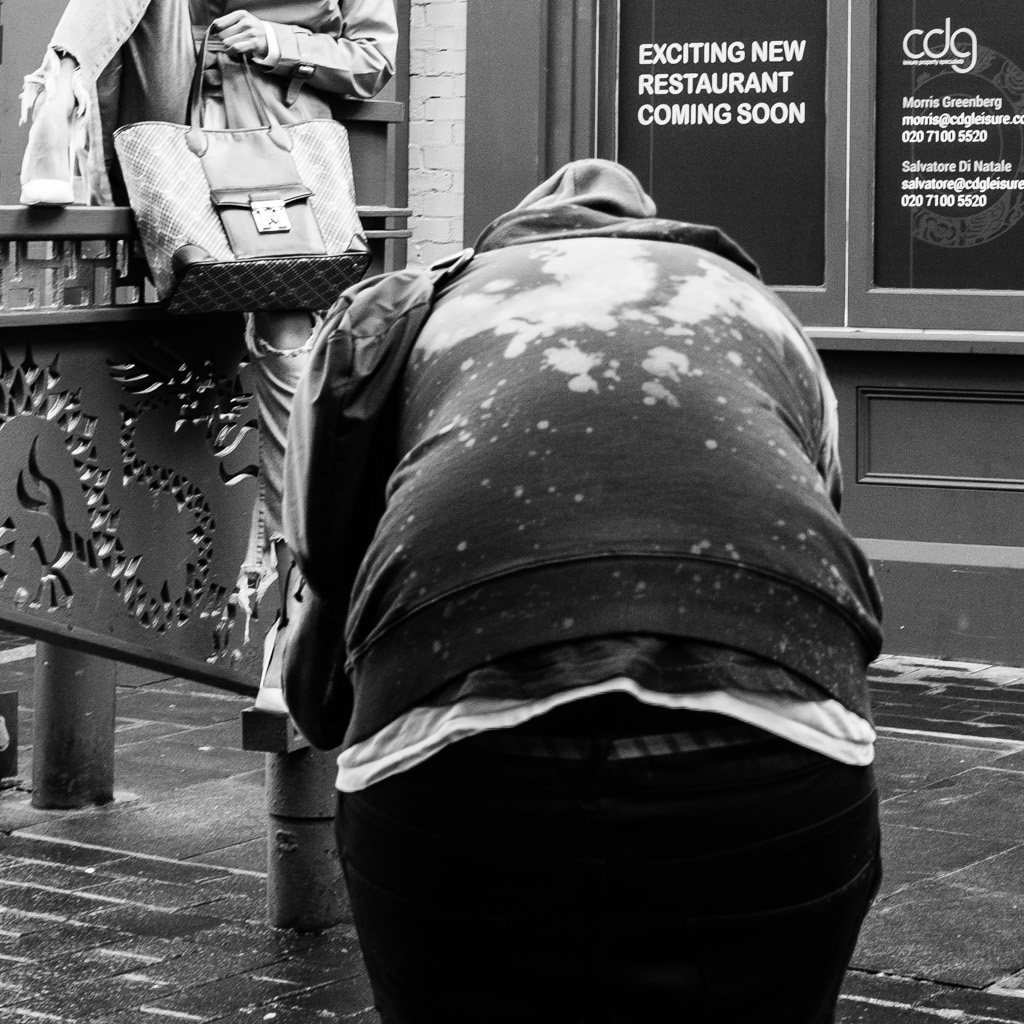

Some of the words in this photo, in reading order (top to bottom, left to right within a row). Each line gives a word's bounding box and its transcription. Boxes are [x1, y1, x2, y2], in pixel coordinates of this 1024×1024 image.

[638, 41, 746, 65] EXCITING
[751, 39, 807, 63] NEW
[902, 17, 978, 74] cdg
[638, 70, 795, 96] RESTAURANT
[902, 95, 940, 109] Morris
[941, 94, 1003, 111] Greenberg
[637, 102, 732, 126] COMING
[736, 101, 806, 125] SOON
[901, 129, 925, 143] 020
[925, 129, 956, 143] 7100
[957, 129, 988, 143] 5520
[901, 159, 957, 173] Salvatore
[958, 159, 972, 173] Di
[973, 159, 1013, 173] Natale
[901, 193, 924, 207] 020
[924, 193, 956, 208] 7100
[957, 194, 988, 208] 5520
